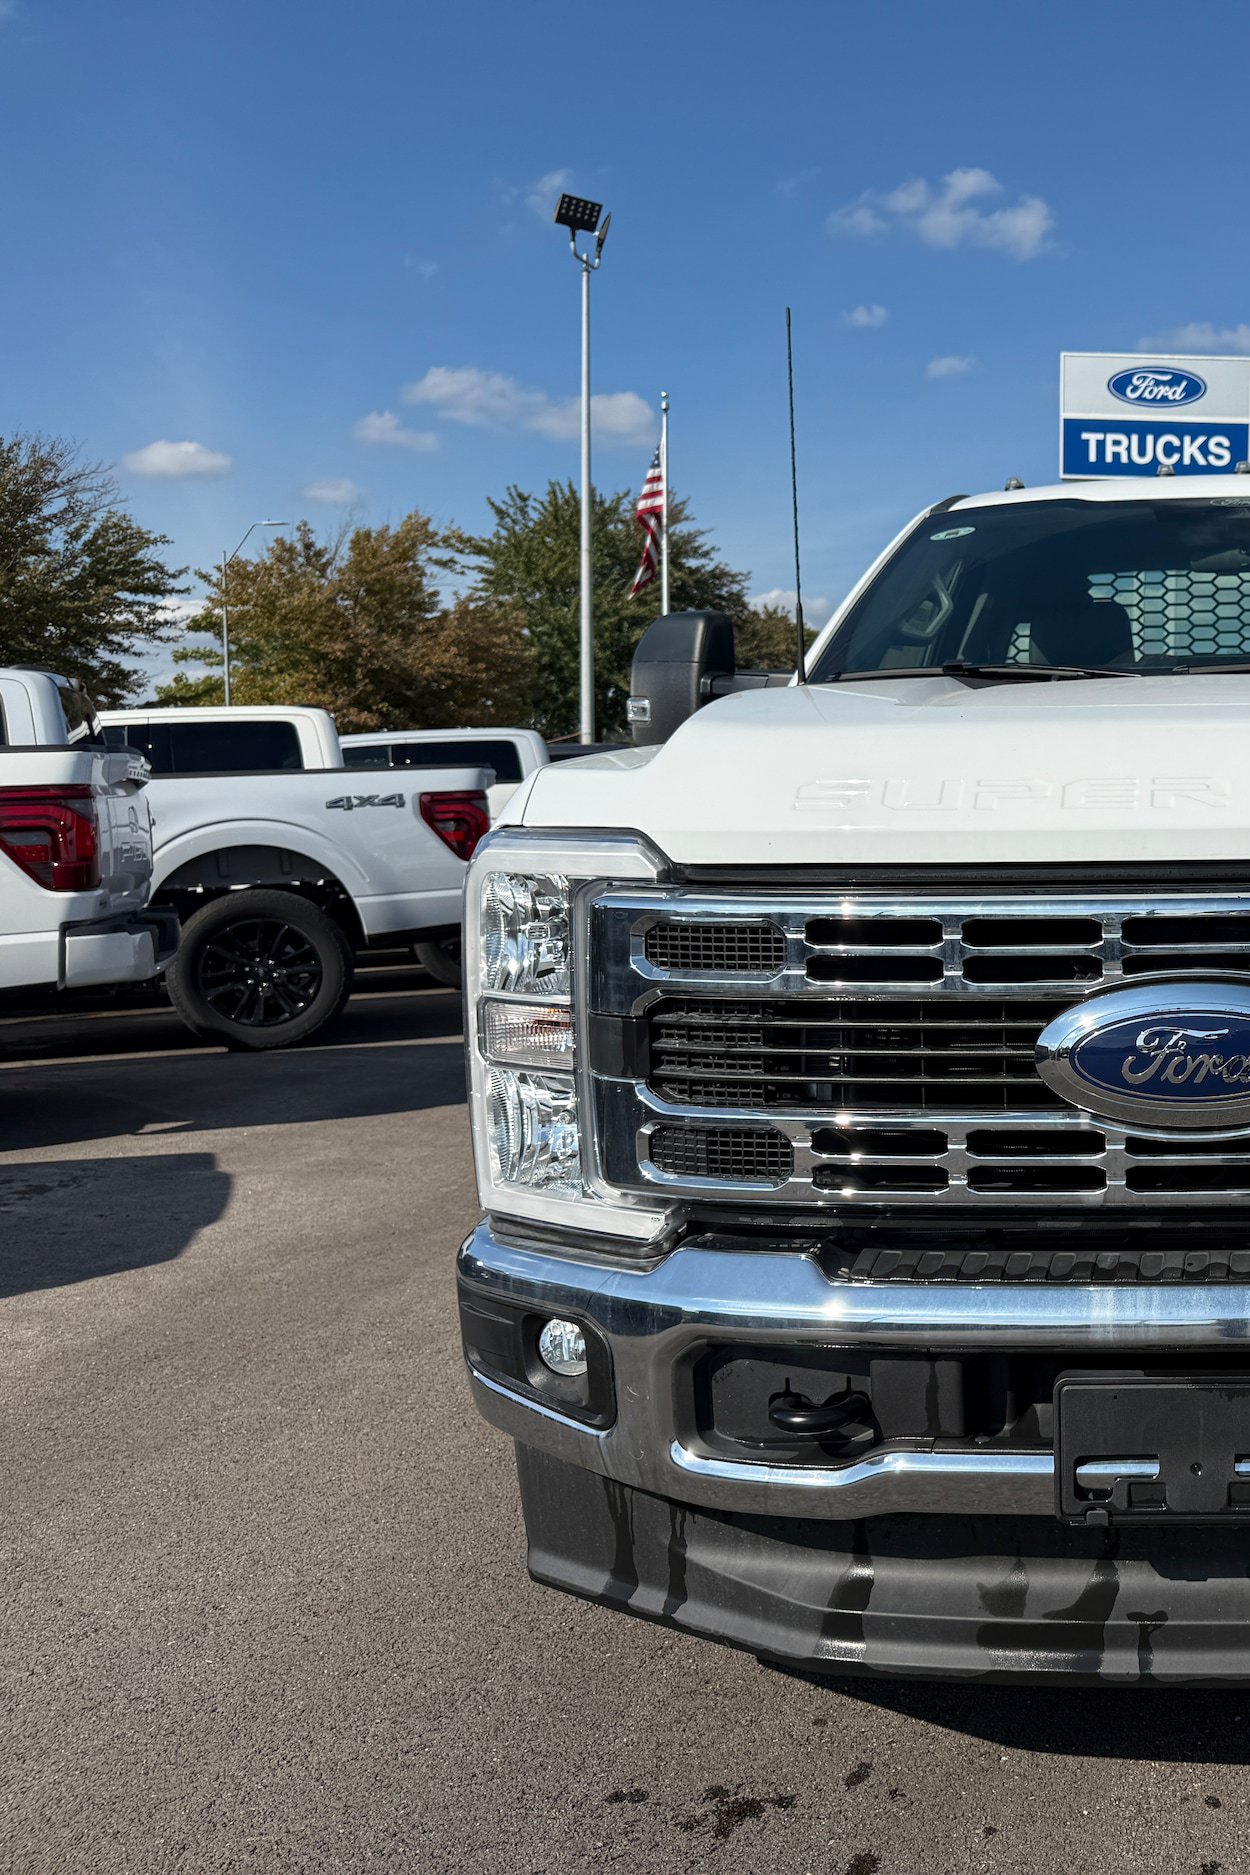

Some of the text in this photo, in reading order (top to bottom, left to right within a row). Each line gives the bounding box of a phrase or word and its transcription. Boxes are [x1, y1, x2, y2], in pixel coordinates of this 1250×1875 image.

[1125, 372, 1187, 400] Ford
[1081, 431, 1232, 467] TRUCKS
[793, 776, 1233, 811] SUPER
